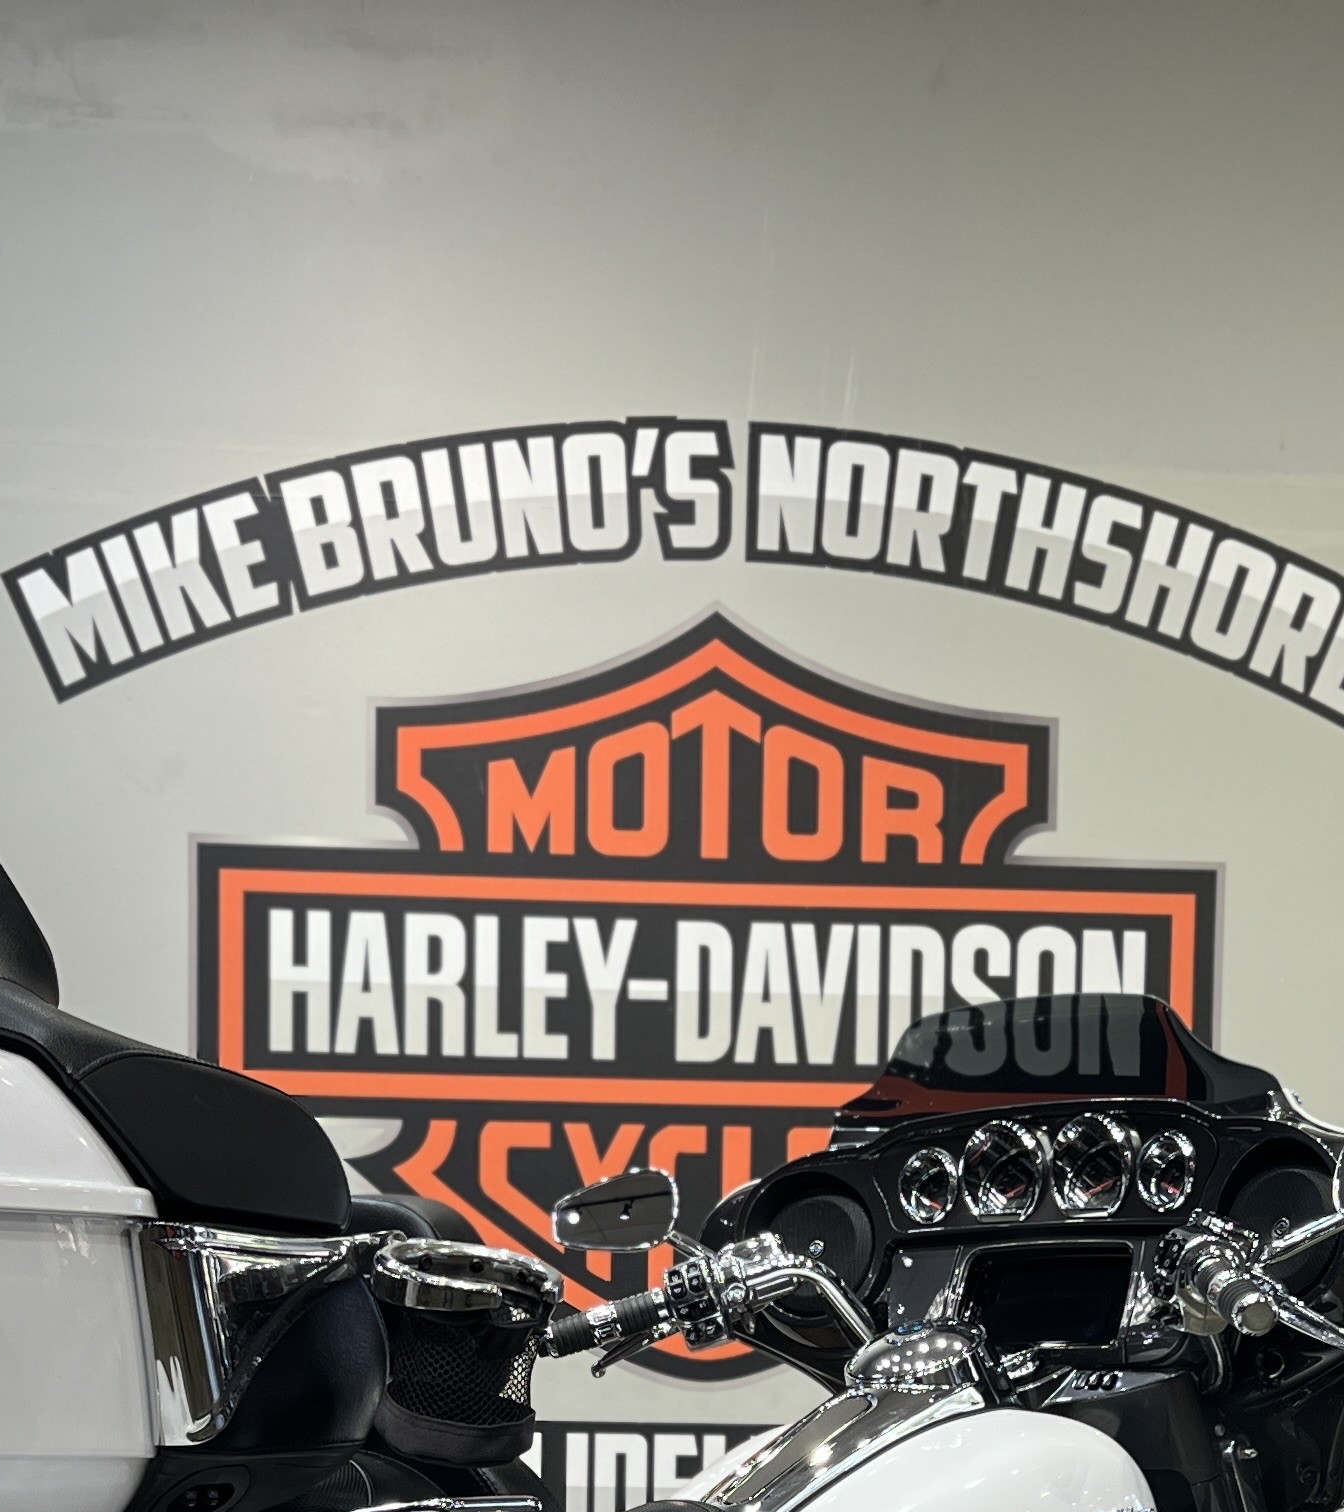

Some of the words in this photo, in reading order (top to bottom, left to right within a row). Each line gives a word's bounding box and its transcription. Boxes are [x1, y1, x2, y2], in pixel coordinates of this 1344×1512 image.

[17, 492, 280, 688] MIKE
[280, 427, 723, 597] BRUNO'S
[487, 689, 945, 864] MOTOR
[267, 907, 1148, 1078] HARLEY-DAVIDSON
